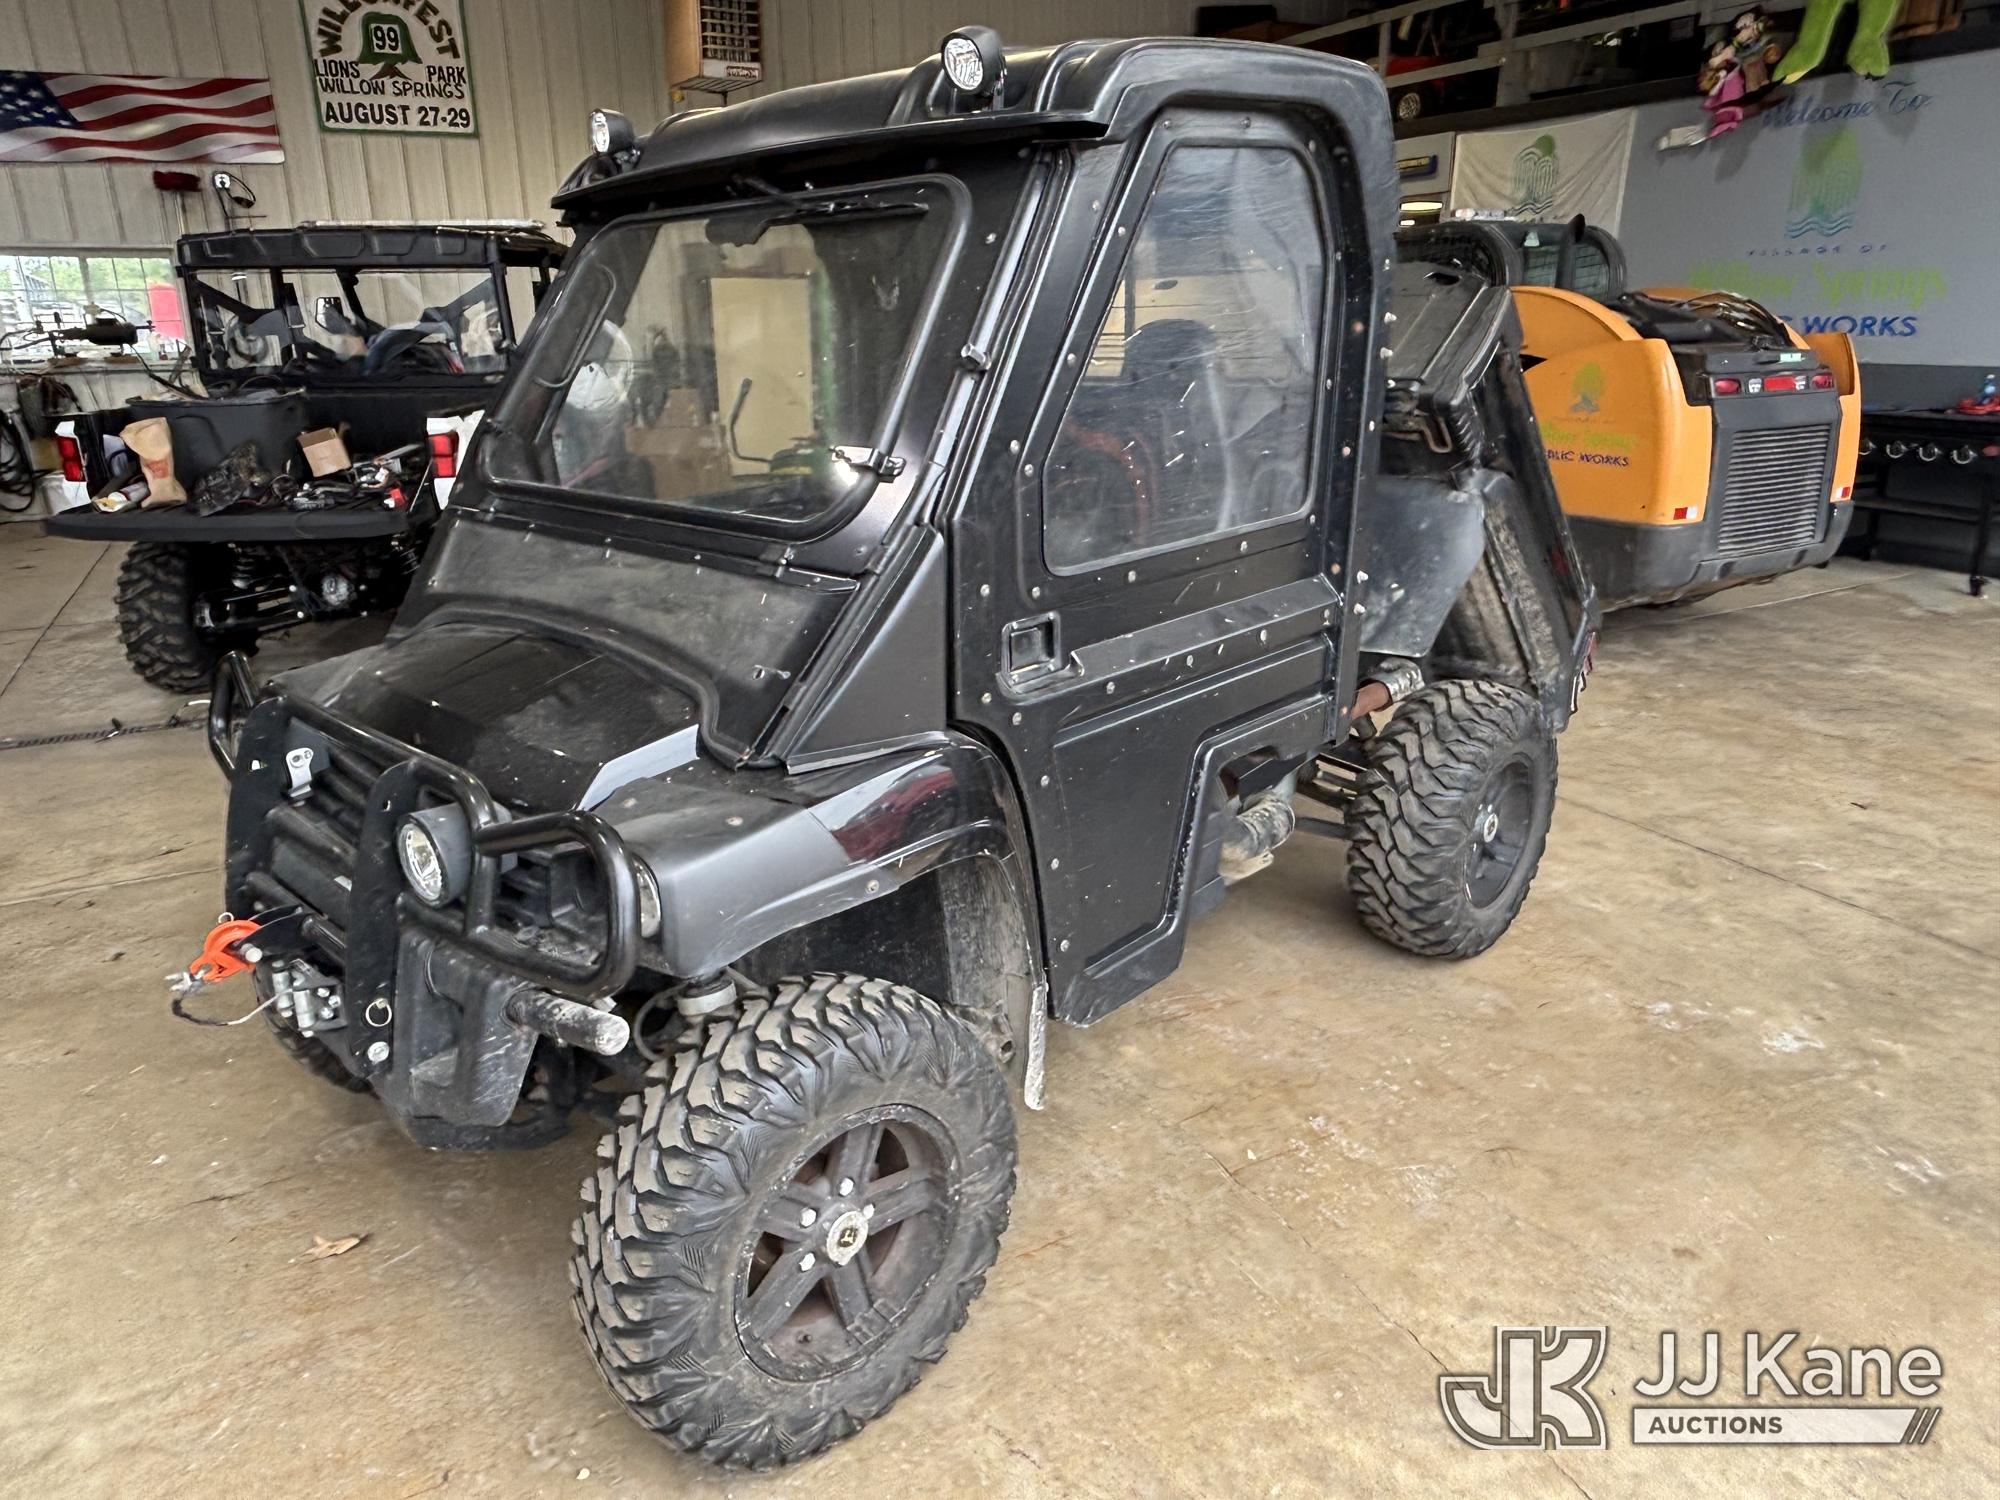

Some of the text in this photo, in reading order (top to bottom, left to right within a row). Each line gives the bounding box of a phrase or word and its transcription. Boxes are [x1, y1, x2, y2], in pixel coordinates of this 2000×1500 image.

[317, 0, 461, 59] WILLEST
[373, 25, 399, 51] 99
[314, 59, 467, 84] LIONS PARK
[318, 77, 465, 99] WILLOW SPRINGS
[325, 101, 471, 128] AUGUST 27-29
[1802, 315, 1917, 337] WORKS
[1579, 453, 1629, 467] WORKS
